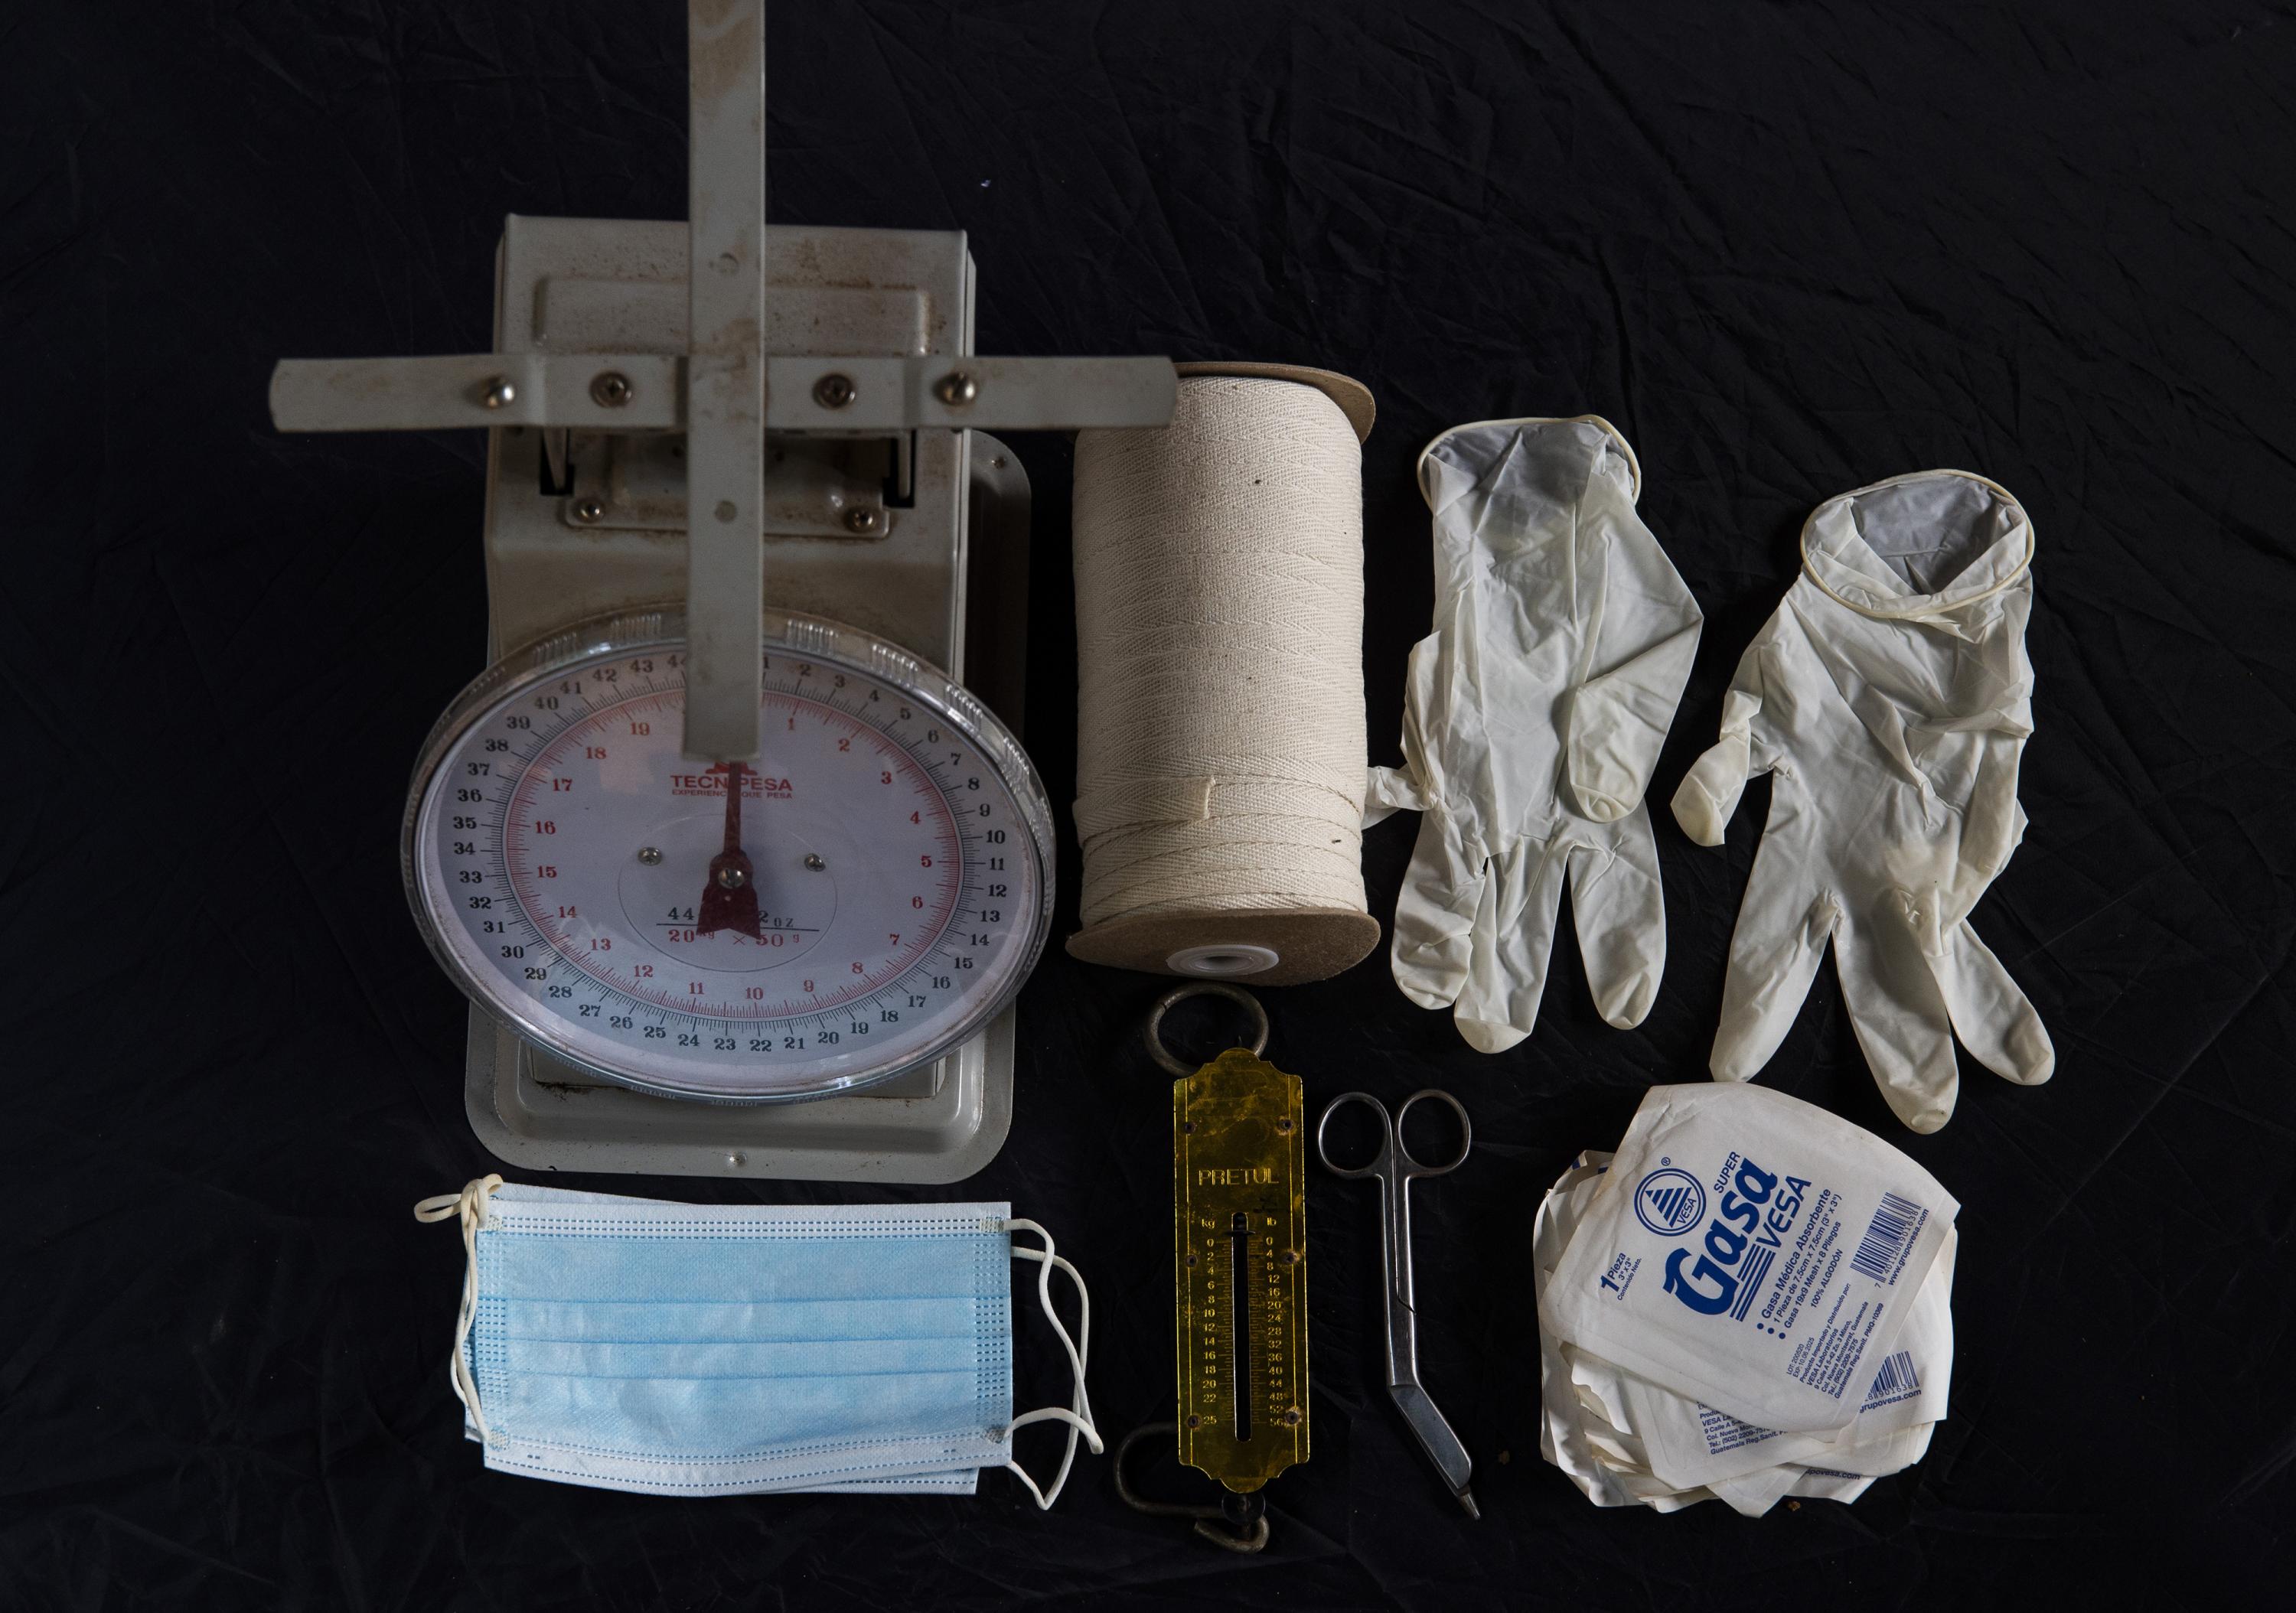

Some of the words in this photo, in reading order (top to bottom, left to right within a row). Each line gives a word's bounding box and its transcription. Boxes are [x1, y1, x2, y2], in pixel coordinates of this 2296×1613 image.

[631, 660, 653, 673] 43
[799, 664, 810, 676] 2
[593, 669, 617, 682] 42
[835, 675, 845, 687] 3
[560, 681, 581, 694] 41
[869, 690, 879, 702] 4
[536, 697, 558, 709] 40
[900, 708, 911, 719] 5
[507, 716, 530, 729] 39
[631, 722, 650, 735] 19
[788, 717, 795, 730] 1
[928, 730, 938, 743] 6
[486, 739, 508, 751] 38
[839, 739, 850, 751] 2
[587, 747, 606, 759] 18
[951, 753, 961, 765] 7
[468, 763, 489, 775] 37
[670, 775, 793, 791] TECNPESA
[882, 772, 891, 784] 3
[968, 778, 980, 790] 8
[553, 779, 572, 790] 17
[458, 789, 481, 802] 36
[980, 804, 990, 816] 9
[453, 816, 476, 829] 35
[911, 811, 920, 823] 4
[536, 821, 555, 834] 16
[987, 830, 1005, 843] 10
[455, 842, 475, 855] 34
[921, 855, 931, 867] 5
[990, 858, 1004, 870] 11
[459, 871, 481, 883] 33
[538, 866, 556, 878] 15
[989, 885, 1006, 897] 12
[470, 897, 491, 909] 32
[912, 897, 923, 908] 6
[559, 906, 577, 917] 14
[668, 907, 694, 921] 44
[981, 911, 1000, 922] 13
[484, 921, 504, 933] 31
[592, 939, 611, 950] 13
[668, 930, 694, 943] 20
[756, 934, 784, 947] 50
[890, 934, 899, 945] 7
[971, 934, 989, 946] 14
[501, 946, 523, 958] 30
[853, 962, 863, 973] 8
[955, 957, 973, 969] 15
[524, 967, 546, 979] 29
[634, 966, 653, 977] 12
[690, 982, 704, 994] 11
[804, 980, 814, 992] 9
[933, 976, 950, 989] 16
[549, 985, 573, 998] 28
[746, 988, 763, 999] 10
[909, 995, 926, 1007] 17
[579, 1005, 600, 1016] 27
[881, 1010, 899, 1022] 18
[610, 1016, 632, 1028] 26
[851, 1022, 868, 1034] 19
[644, 1026, 666, 1038] 25
[818, 1031, 839, 1044] 20
[678, 1035, 700, 1046] 24
[714, 1038, 735, 1050] 23
[750, 1040, 771, 1051] 22
[784, 1037, 804, 1049] 21
[1199, 1168, 1280, 1185] PRETUL
[1714, 1152, 1740, 1193] SUPER
[1677, 1198, 1696, 1224] VESA
[1756, 1176, 1812, 1247] VESA
[1202, 1218, 1215, 1229] kg
[1267, 1217, 1277, 1226] lb
[1266, 1237, 1274, 1245] 0
[1663, 1157, 1778, 1315] Gasa
[1883, 1246, 1901, 1273] 401128
[1898, 1210, 1918, 1241] 901638
[1207, 1239, 1215, 1247] 0
[1889, 1209, 1929, 1285] www.grupovesa.com
[1207, 1252, 1214, 1261] 2
[1267, 1250, 1273, 1258] 4
[1762, 1292, 1780, 1318] Gasa
[1776, 1252, 1800, 1290] Médica
[1796, 1189, 1831, 1251] Absorbente
[1776, 1295, 1792, 1317] Pieza
[1789, 1284, 1797, 1294] de
[1793, 1259, 1809, 1282] 7.5cm
[1808, 1227, 1825, 1250] 7.5cm
[1821, 1214, 1829, 1227] (3"
[1831, 1194, 1841, 1207] 3")
[1607, 1253, 1626, 1279] Pieza
[1268, 1275, 1280, 1283] 12
[1617, 1272, 1635, 1300] Contenido
[1632, 1259, 1641, 1272] Neto.
[1785, 1308, 1799, 1328] Gasa
[1795, 1287, 1808, 1305] 19x9
[1805, 1265, 1819, 1287] Mesh
[1822, 1222, 1841, 1251] Pliegos
[1811, 1289, 1824, 1307] 100%
[1821, 1249, 1842, 1288] ALGODÓN
[1208, 1281, 1215, 1289] 6
[1601, 1276, 1619, 1292] 1
[1268, 1288, 1280, 1296] 16
[1267, 1301, 1281, 1310] 20
[1204, 1309, 1215, 1318] 10
[1267, 1314, 1280, 1322] 24
[1204, 1323, 1215, 1332] 12
[1267, 1327, 1282, 1335] 28
[1204, 1338, 1215, 1346] 14
[1268, 1340, 1282, 1348] 32
[1800, 1357, 1815, 1383] Producto
[1812, 1329, 1828, 1357] Importado
[1828, 1295, 1844, 1325] Distribuido
[1821, 1382, 1830, 1392] Col.
[1828, 1364, 1838, 1380] Nueva
[1836, 1332, 1854, 1363] Montserrat,
[1851, 1302, 1868, 1331] Guatemala
[1204, 1351, 1216, 1360] 16
[1268, 1353, 1283, 1362] 36
[1807, 1368, 1819, 1385] VESA
[1816, 1328, 1838, 1367] Laboratorios
[1205, 1366, 1216, 1374] 18
[1269, 1366, 1283, 1375] 40
[1828, 1384, 1837, 1395] Tel.:
[1834, 1369, 1844, 1383] (502)
[1841, 1338, 1857, 1369] 2209-7575
[1202, 1380, 1216, 1389] 20
[1270, 1379, 1282, 1387] 44
[1202, 1393, 1216, 1403] 22
[1203, 1416, 1217, 1425] 25
